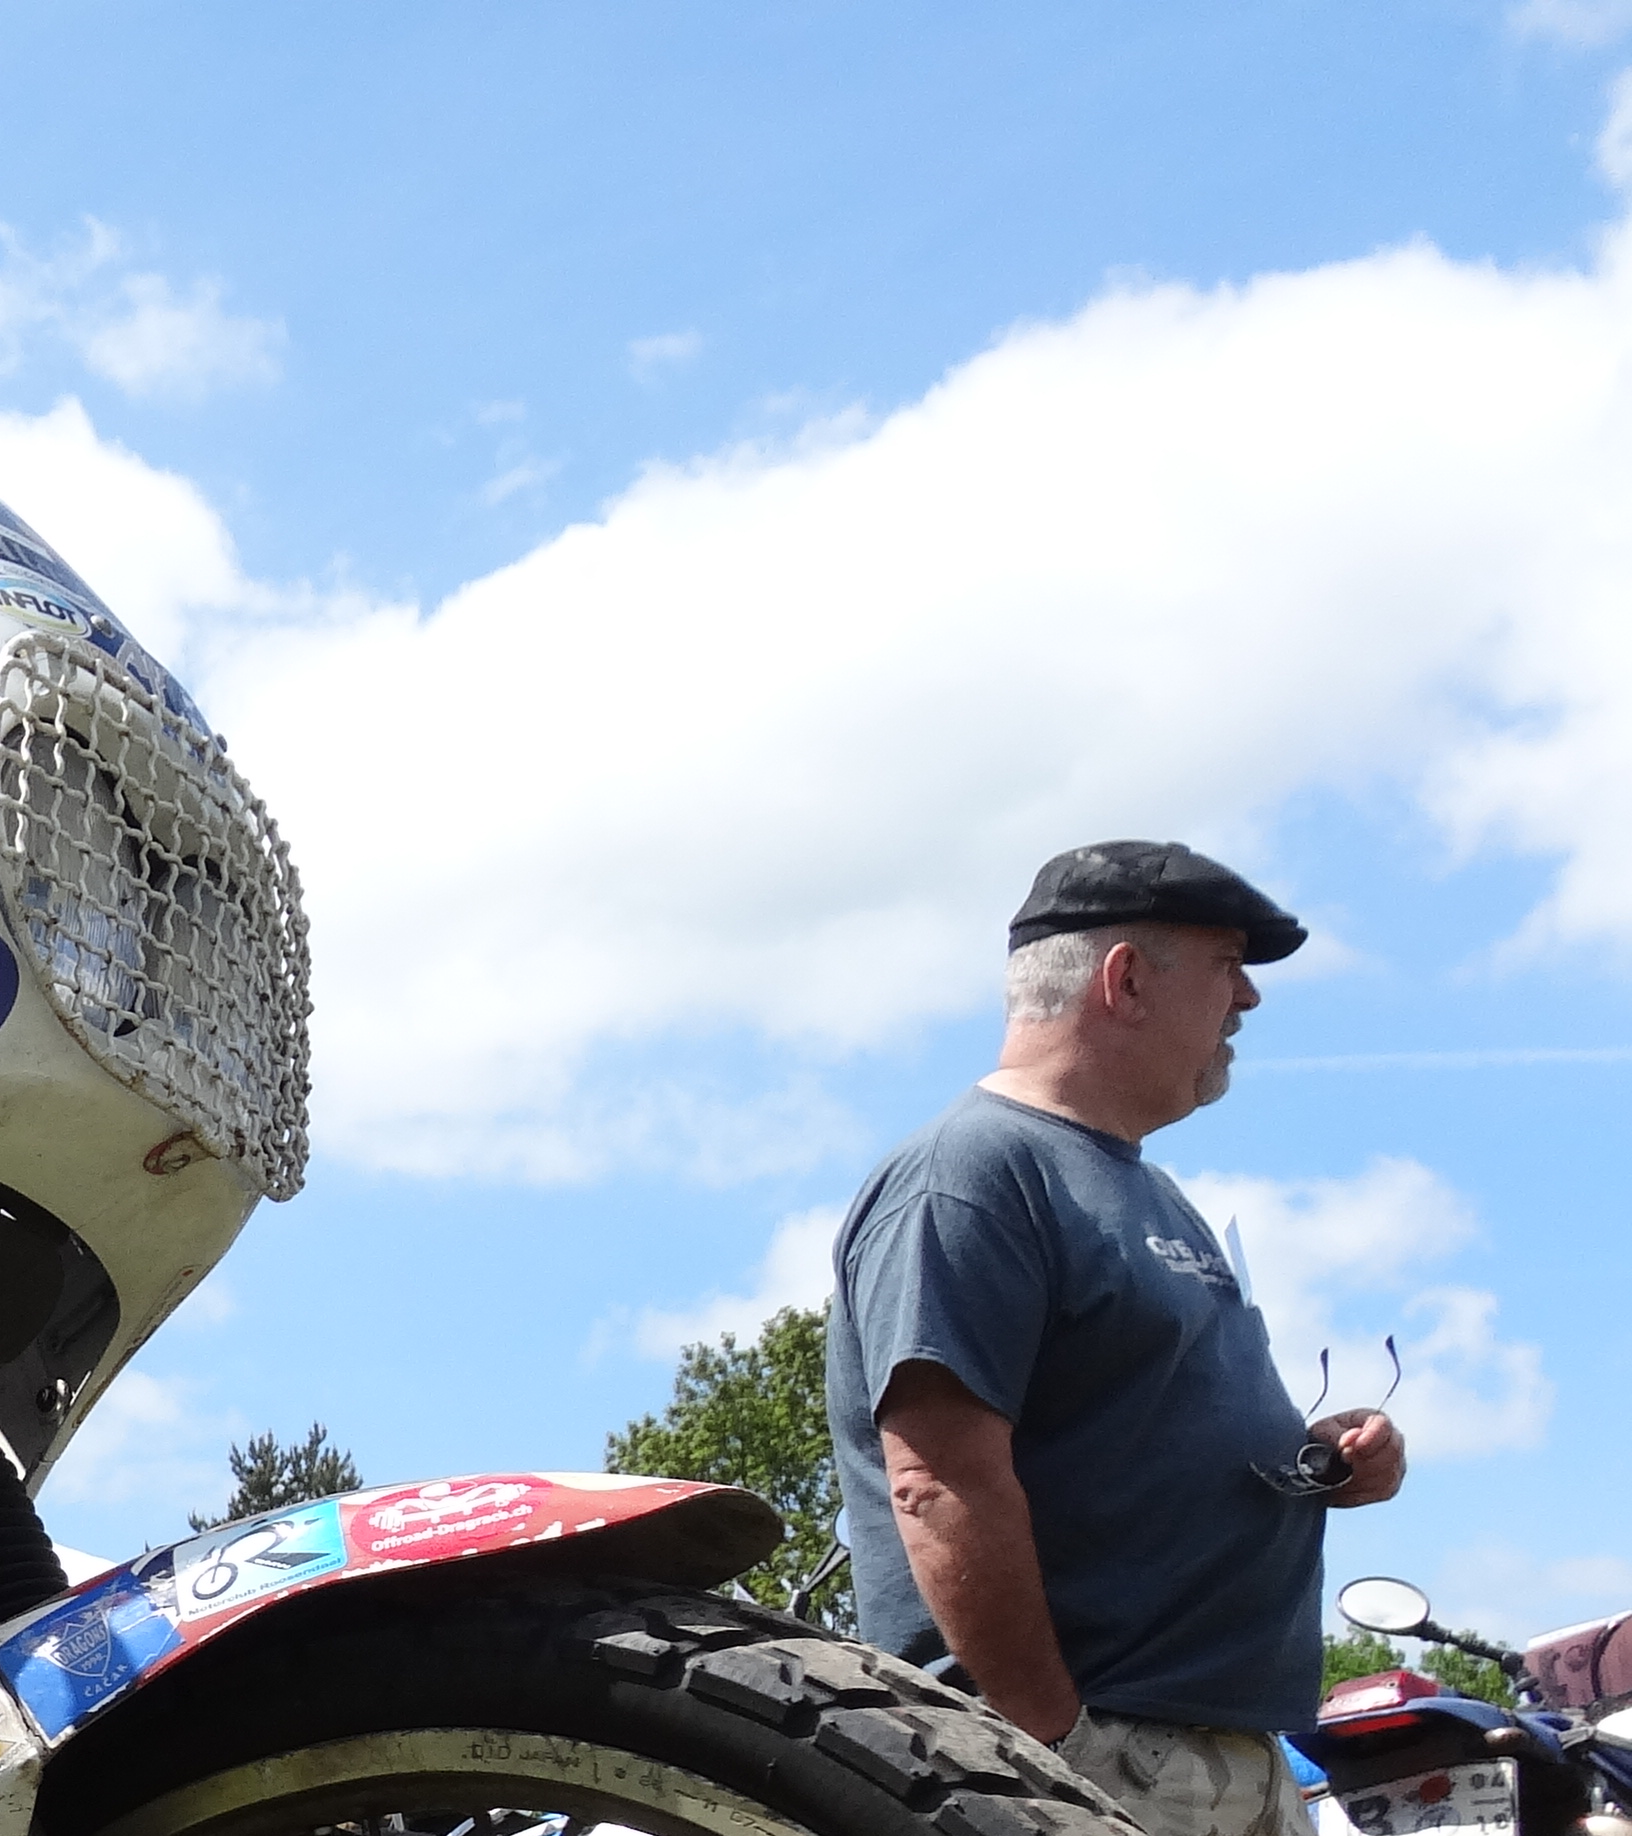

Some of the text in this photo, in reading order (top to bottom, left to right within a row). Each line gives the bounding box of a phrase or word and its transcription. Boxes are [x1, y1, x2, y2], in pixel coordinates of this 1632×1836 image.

[369, 1502, 535, 1553] Offroad-Dragrace.ch
[187, 1556, 344, 1617] Motorclub Roosendaal
[55, 1625, 110, 1668] DRAGONS
[84, 1661, 130, 1699] ČAČAK
